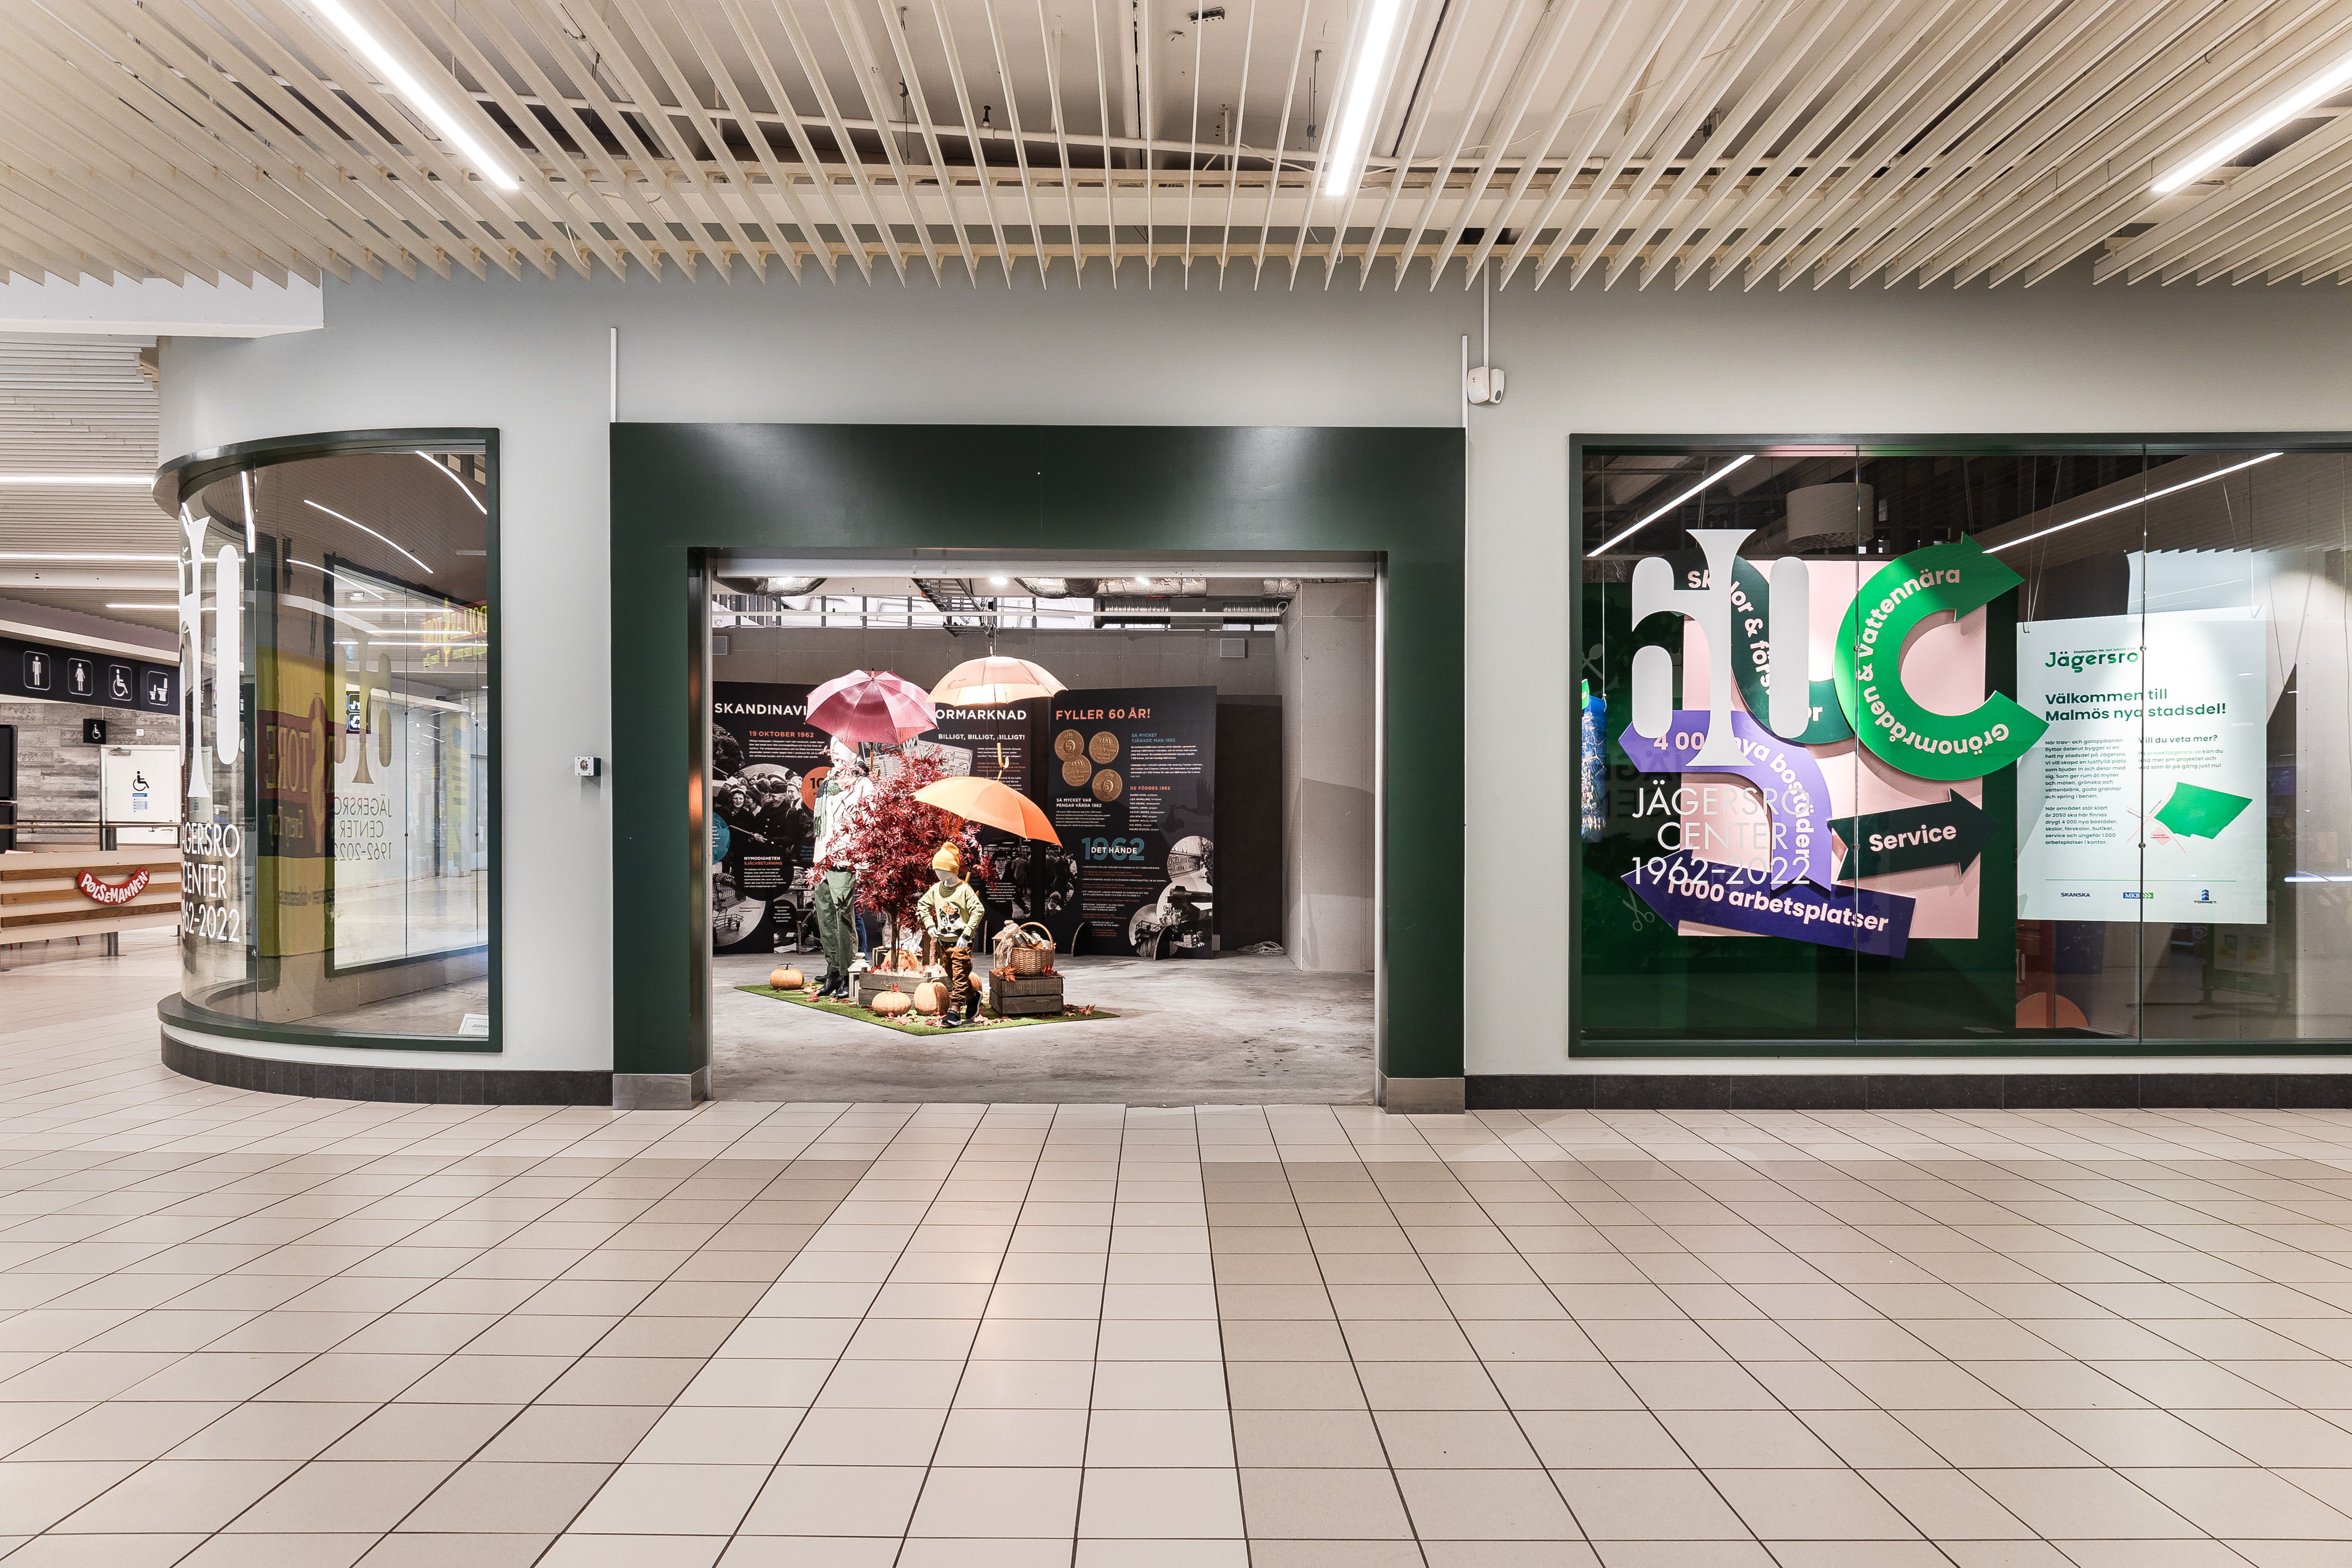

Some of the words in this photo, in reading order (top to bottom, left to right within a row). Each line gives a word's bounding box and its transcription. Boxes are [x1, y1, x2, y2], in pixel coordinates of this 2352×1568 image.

[1688, 569, 1754, 612] Sklor
[1745, 619, 1763, 638] &
[1856, 663, 1874, 681] &
[2045, 651, 2138, 673] Jägersro
[715, 703, 807, 715] SKANDINAVI
[2045, 692, 2143, 704] Välkommen
[2148, 688, 2167, 699] till
[935, 709, 1026, 720] ORMARKNAD
[1056, 710, 1103, 720] FYLLER
[1109, 709, 1125, 719] 60
[1128, 707, 1151, 719] ÅR!
[1863, 686, 2009, 755] Grönområden
[2046, 708, 2109, 721] Malmös
[2114, 709, 2143, 721] nya
[2148, 703, 2225, 717] stadsdel!
[1632, 780, 1810, 818] JÄGERSRO
[1675, 732, 1706, 750] 00
[1769, 752, 1815, 860] bostäder
[1082, 838, 1144, 861] 1962
[1658, 822, 1788, 850] CENTER
[1869, 824, 1956, 852] Service
[183, 861, 227, 899] CENTER
[1632, 857, 1810, 885] 1962-2022
[81, 871, 148, 903] PØLSEMANNEN
[1728, 890, 1889, 932] arbetsplatser
